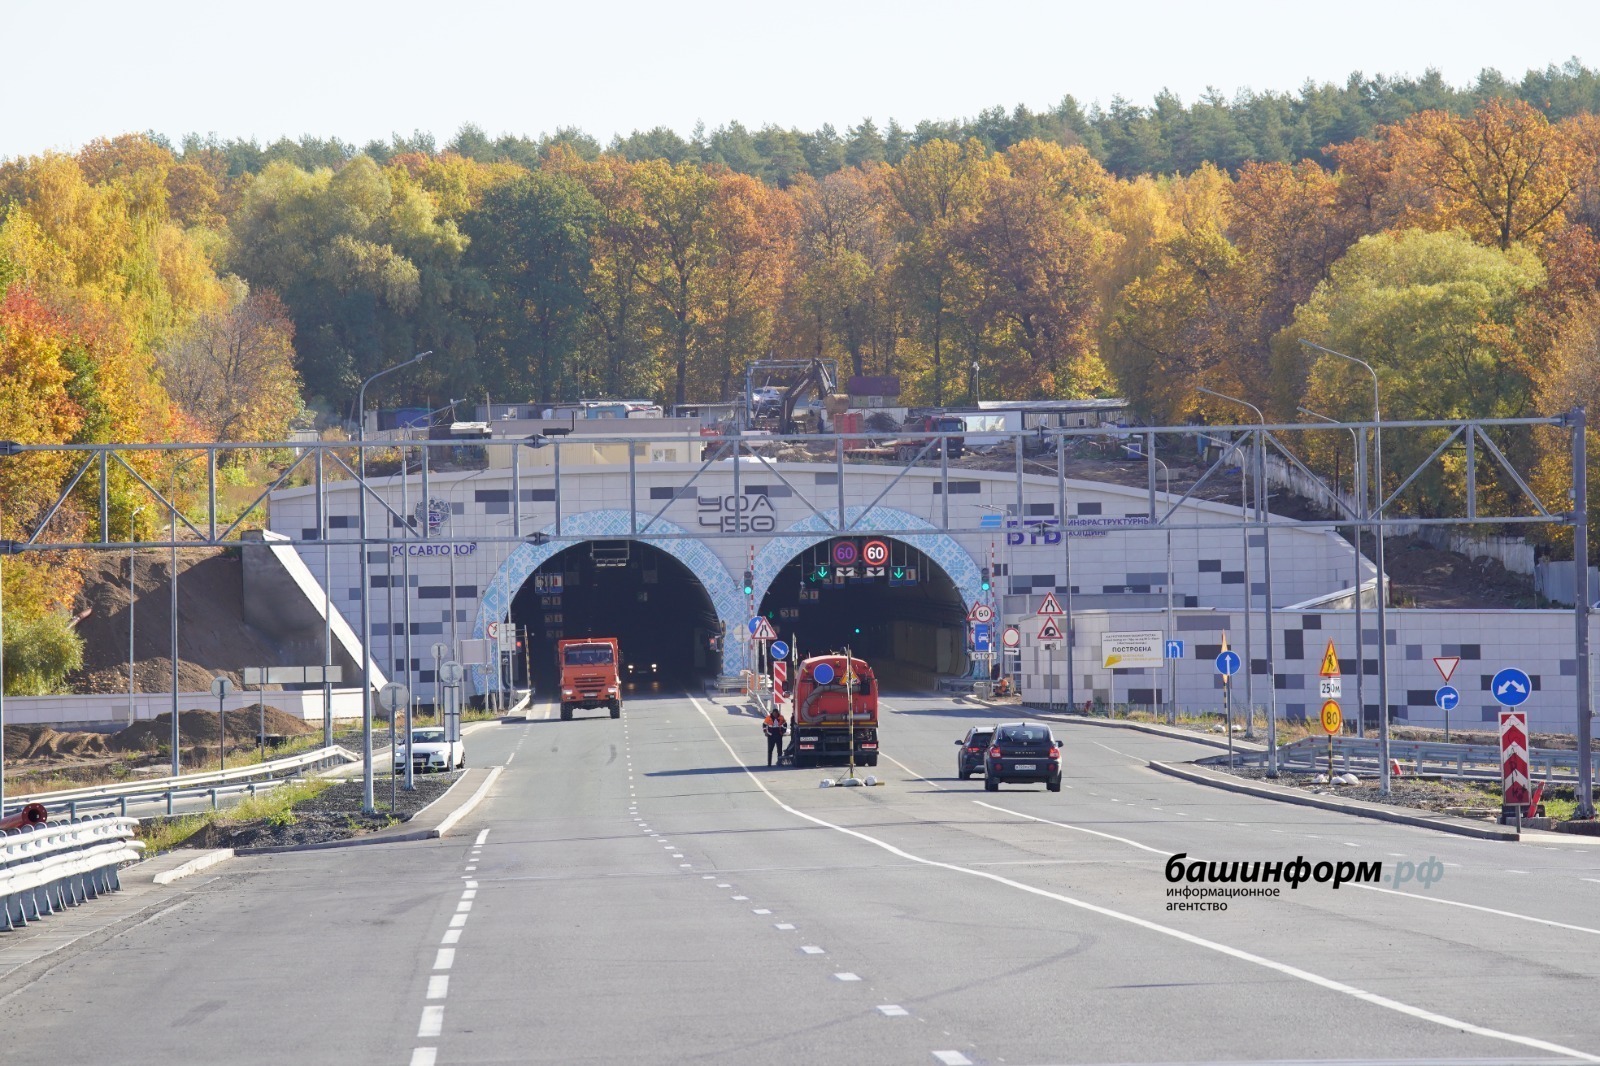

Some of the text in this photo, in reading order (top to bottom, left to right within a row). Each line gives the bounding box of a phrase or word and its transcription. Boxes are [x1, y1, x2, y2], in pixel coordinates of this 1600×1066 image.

[837, 547, 854, 560] 60
[867, 546, 884, 560] 60
[978, 609, 989, 618] 60
[1326, 711, 1338, 725] 80
